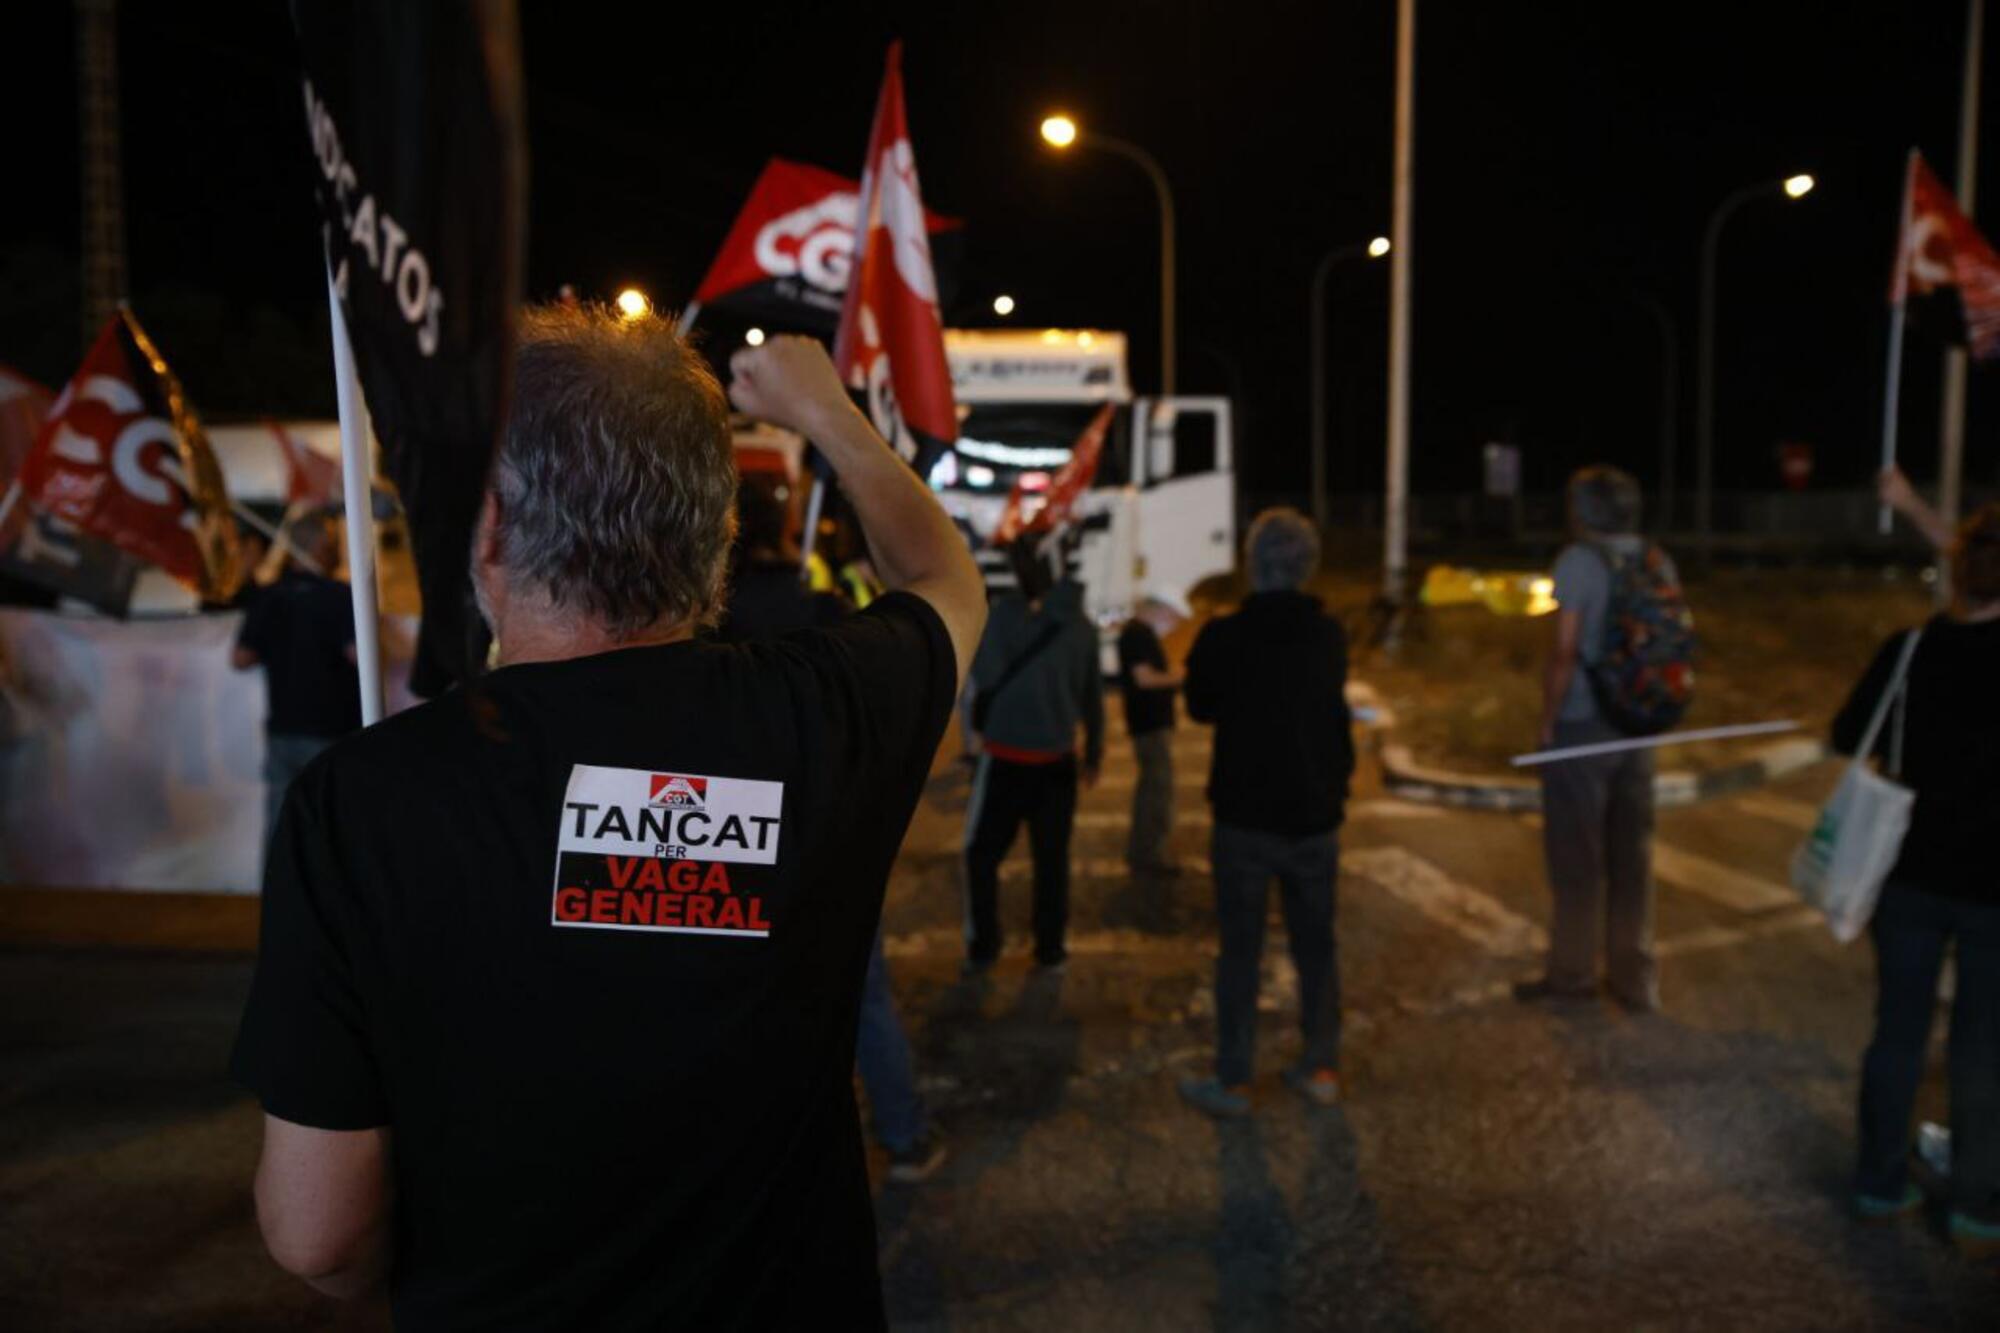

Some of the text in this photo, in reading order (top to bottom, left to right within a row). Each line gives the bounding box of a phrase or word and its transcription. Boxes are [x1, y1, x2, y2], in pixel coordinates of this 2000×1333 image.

[565, 802, 780, 851] TANCAT
[654, 844, 687, 859] PER
[606, 855, 732, 895] VAGA
[555, 887, 771, 930] GENERAL
